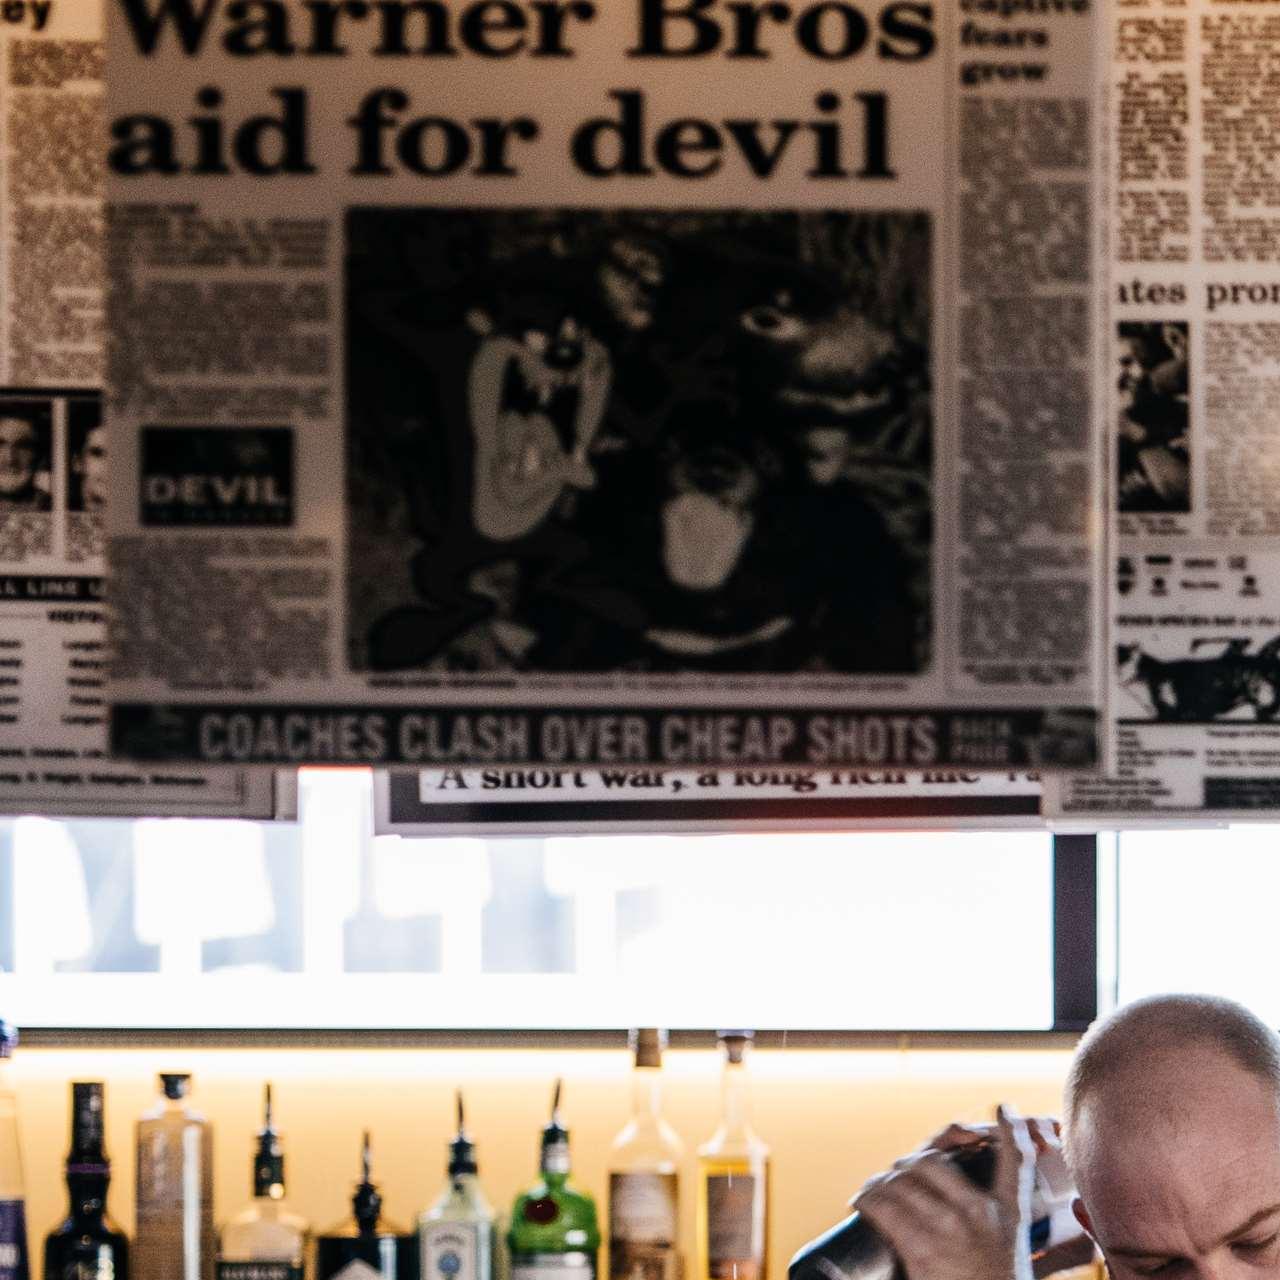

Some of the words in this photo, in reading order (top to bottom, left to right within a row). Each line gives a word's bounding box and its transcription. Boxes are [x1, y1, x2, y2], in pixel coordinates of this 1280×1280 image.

[118, 0, 598, 58] Warner
[626, 0, 936, 61] Bros
[108, 87, 318, 177] aid
[349, 87, 540, 177] for
[570, 88, 897, 179] devil
[201, 715, 387, 762] COACHES
[400, 716, 529, 762] CLASH
[540, 716, 649, 762] OVER
[660, 716, 792, 764] CHEAP
[806, 716, 939, 764] SHOTS
